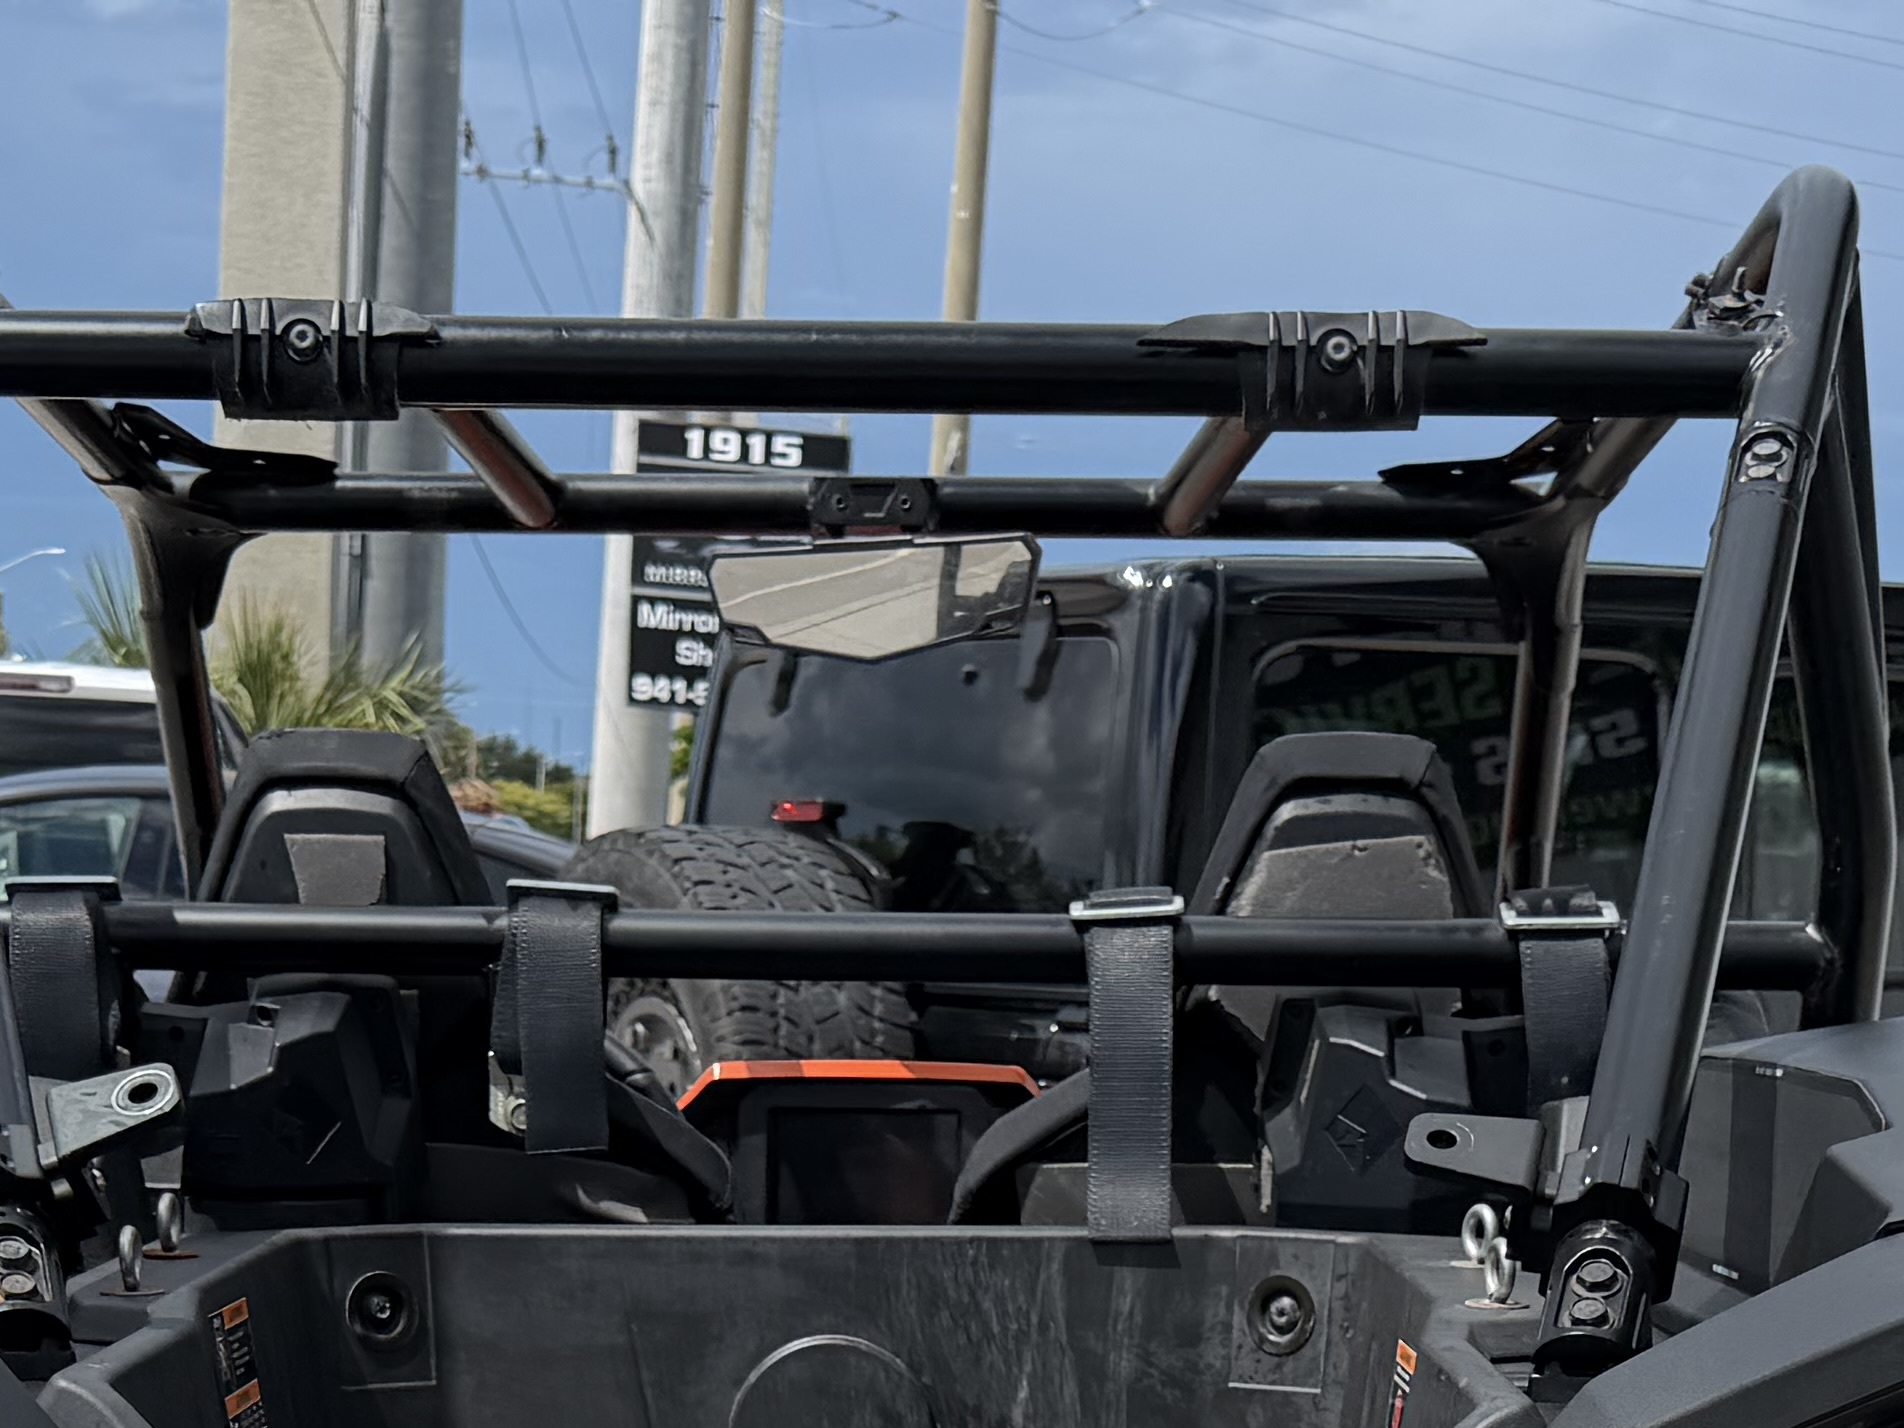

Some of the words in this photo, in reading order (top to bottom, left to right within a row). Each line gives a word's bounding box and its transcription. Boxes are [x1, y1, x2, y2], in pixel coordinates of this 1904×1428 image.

[684, 426, 804, 468] 1915
[675, 638, 714, 667] Sh
[631, 672, 711, 706] 941-5
